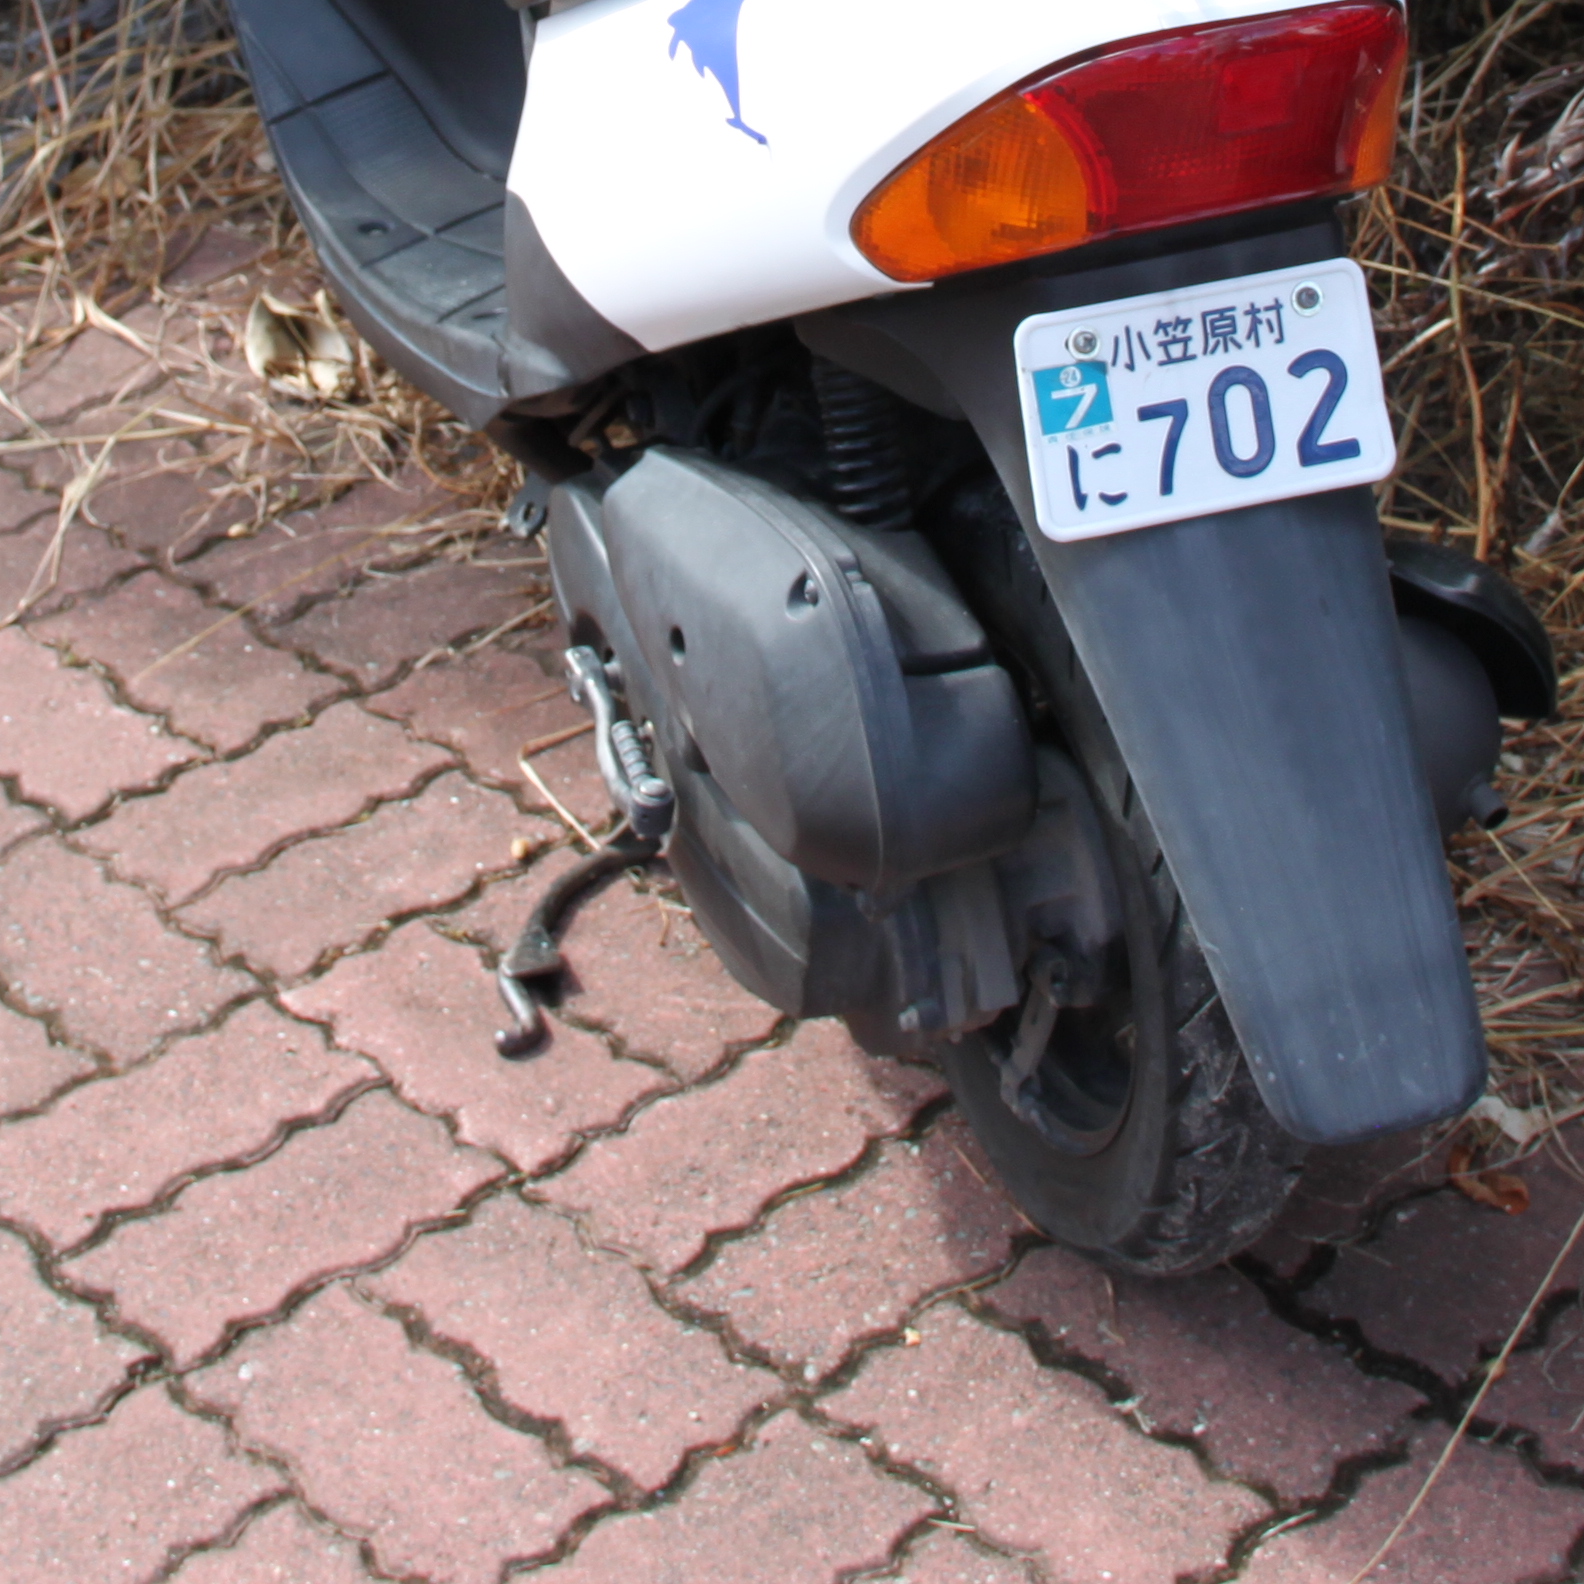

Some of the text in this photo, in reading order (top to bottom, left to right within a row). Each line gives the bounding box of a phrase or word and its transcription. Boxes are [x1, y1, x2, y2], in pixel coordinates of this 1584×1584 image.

[1110, 297, 1286, 372] 小笠原村
[1050, 382, 1098, 430] 7
[1067, 347, 1361, 511] に 702
